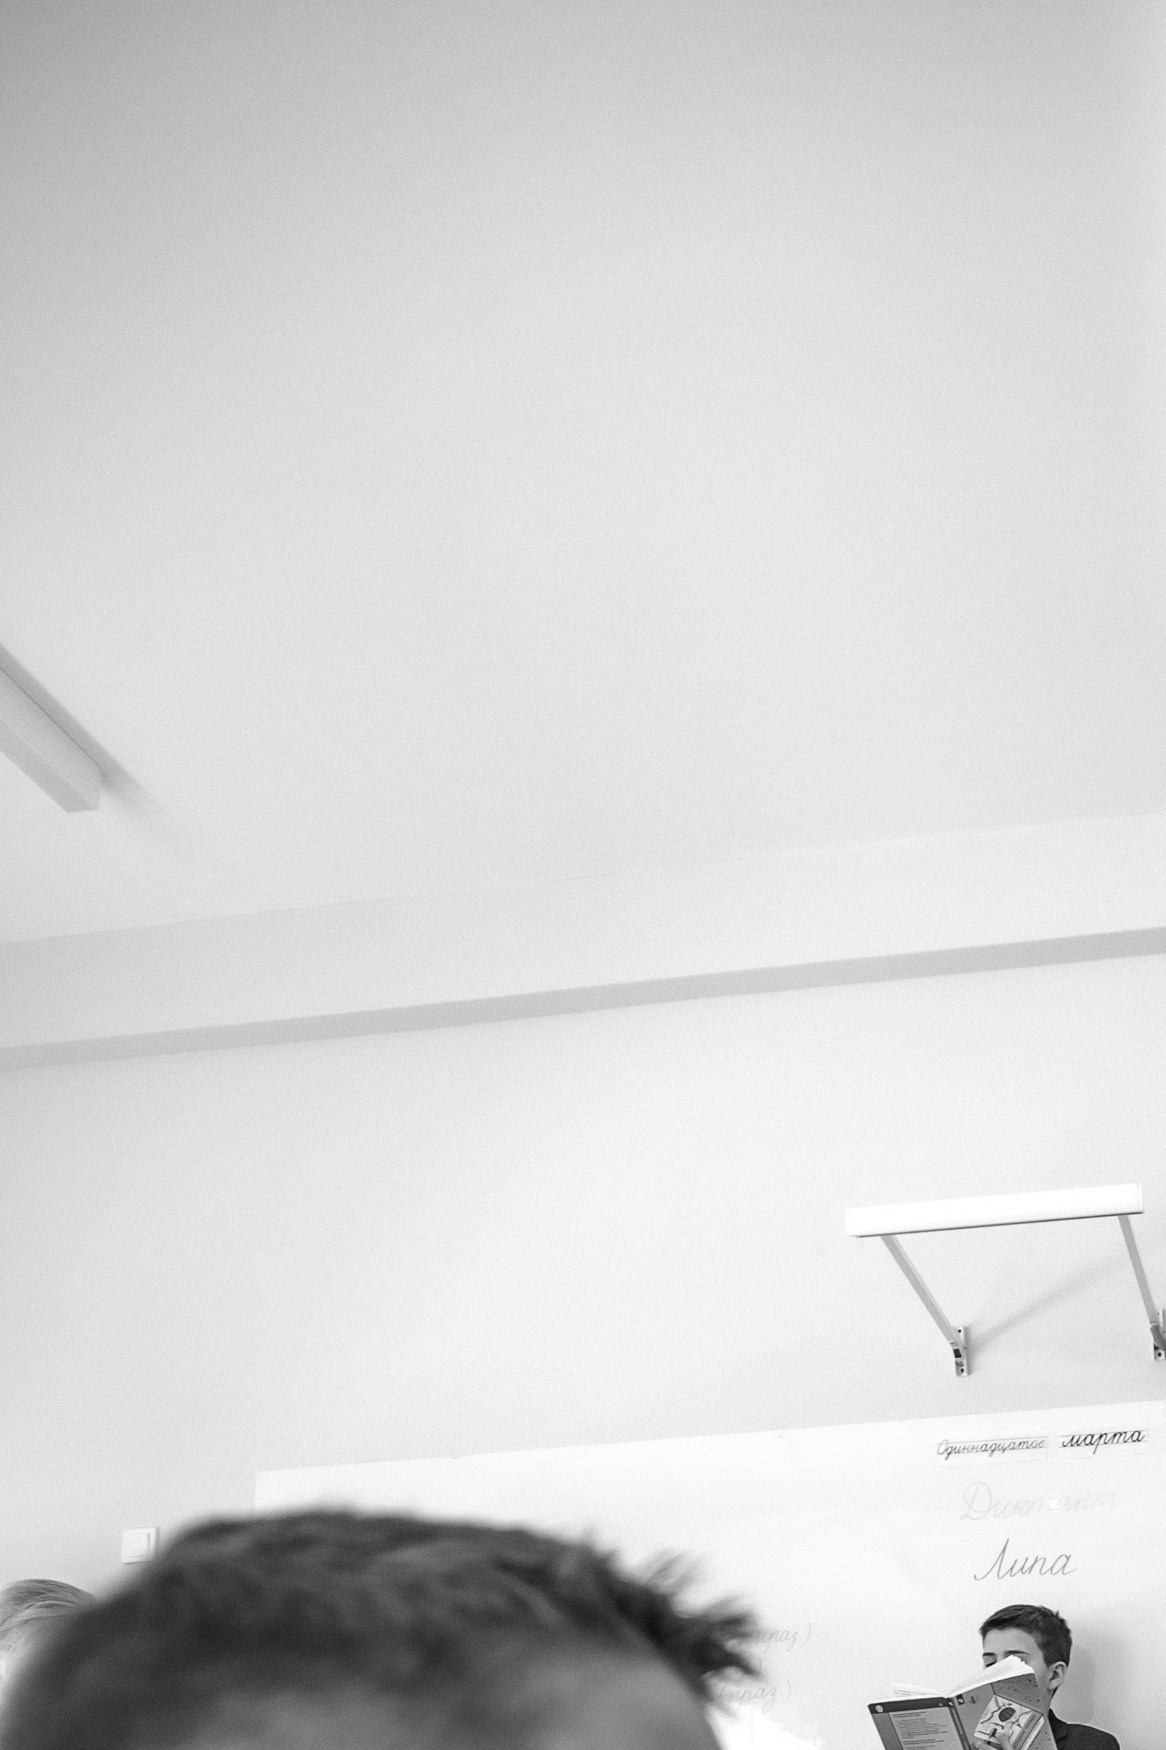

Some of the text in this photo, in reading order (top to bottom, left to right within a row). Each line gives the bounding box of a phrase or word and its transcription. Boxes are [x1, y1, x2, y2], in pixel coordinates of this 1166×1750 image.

[937, 1430, 1146, 1461] Одиннадцатое марта
[973, 1538, 1078, 1581] Липа
